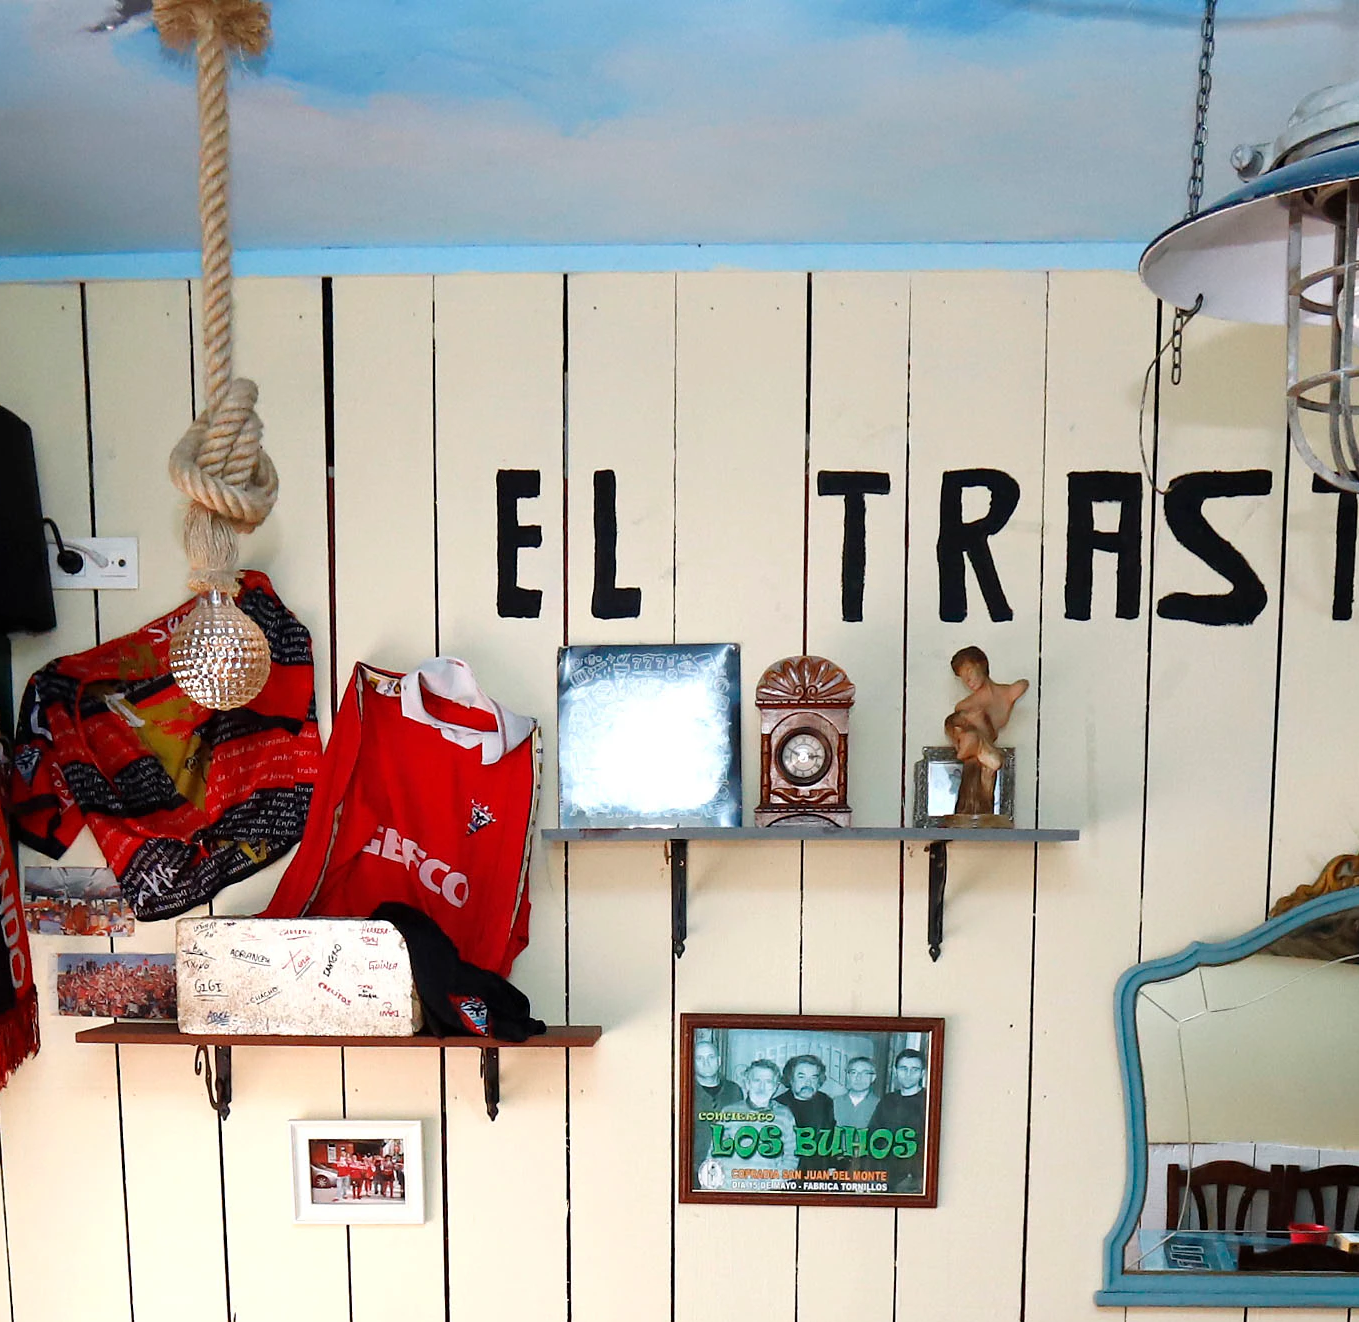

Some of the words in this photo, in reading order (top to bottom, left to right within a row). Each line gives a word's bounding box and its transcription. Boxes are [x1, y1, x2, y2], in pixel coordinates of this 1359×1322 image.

[497, 469, 641, 618] EL
[710, 1124, 783, 1158] LOS
[794, 1126, 918, 1159] BUHOS
[732, 1181, 746, 1189] DIA
[749, 1181, 759, 1189] 15
[773, 1181, 797, 1190] MAYO
[803, 1182, 839, 1191] FABRICA
[841, 1182, 888, 1191] TORNILLOS
[782, 1169, 802, 1179] SAN
[804, 1170, 829, 1180] JUAN
[833, 1170, 850, 1180] DEL
[853, 1170, 887, 1181] MONTE
